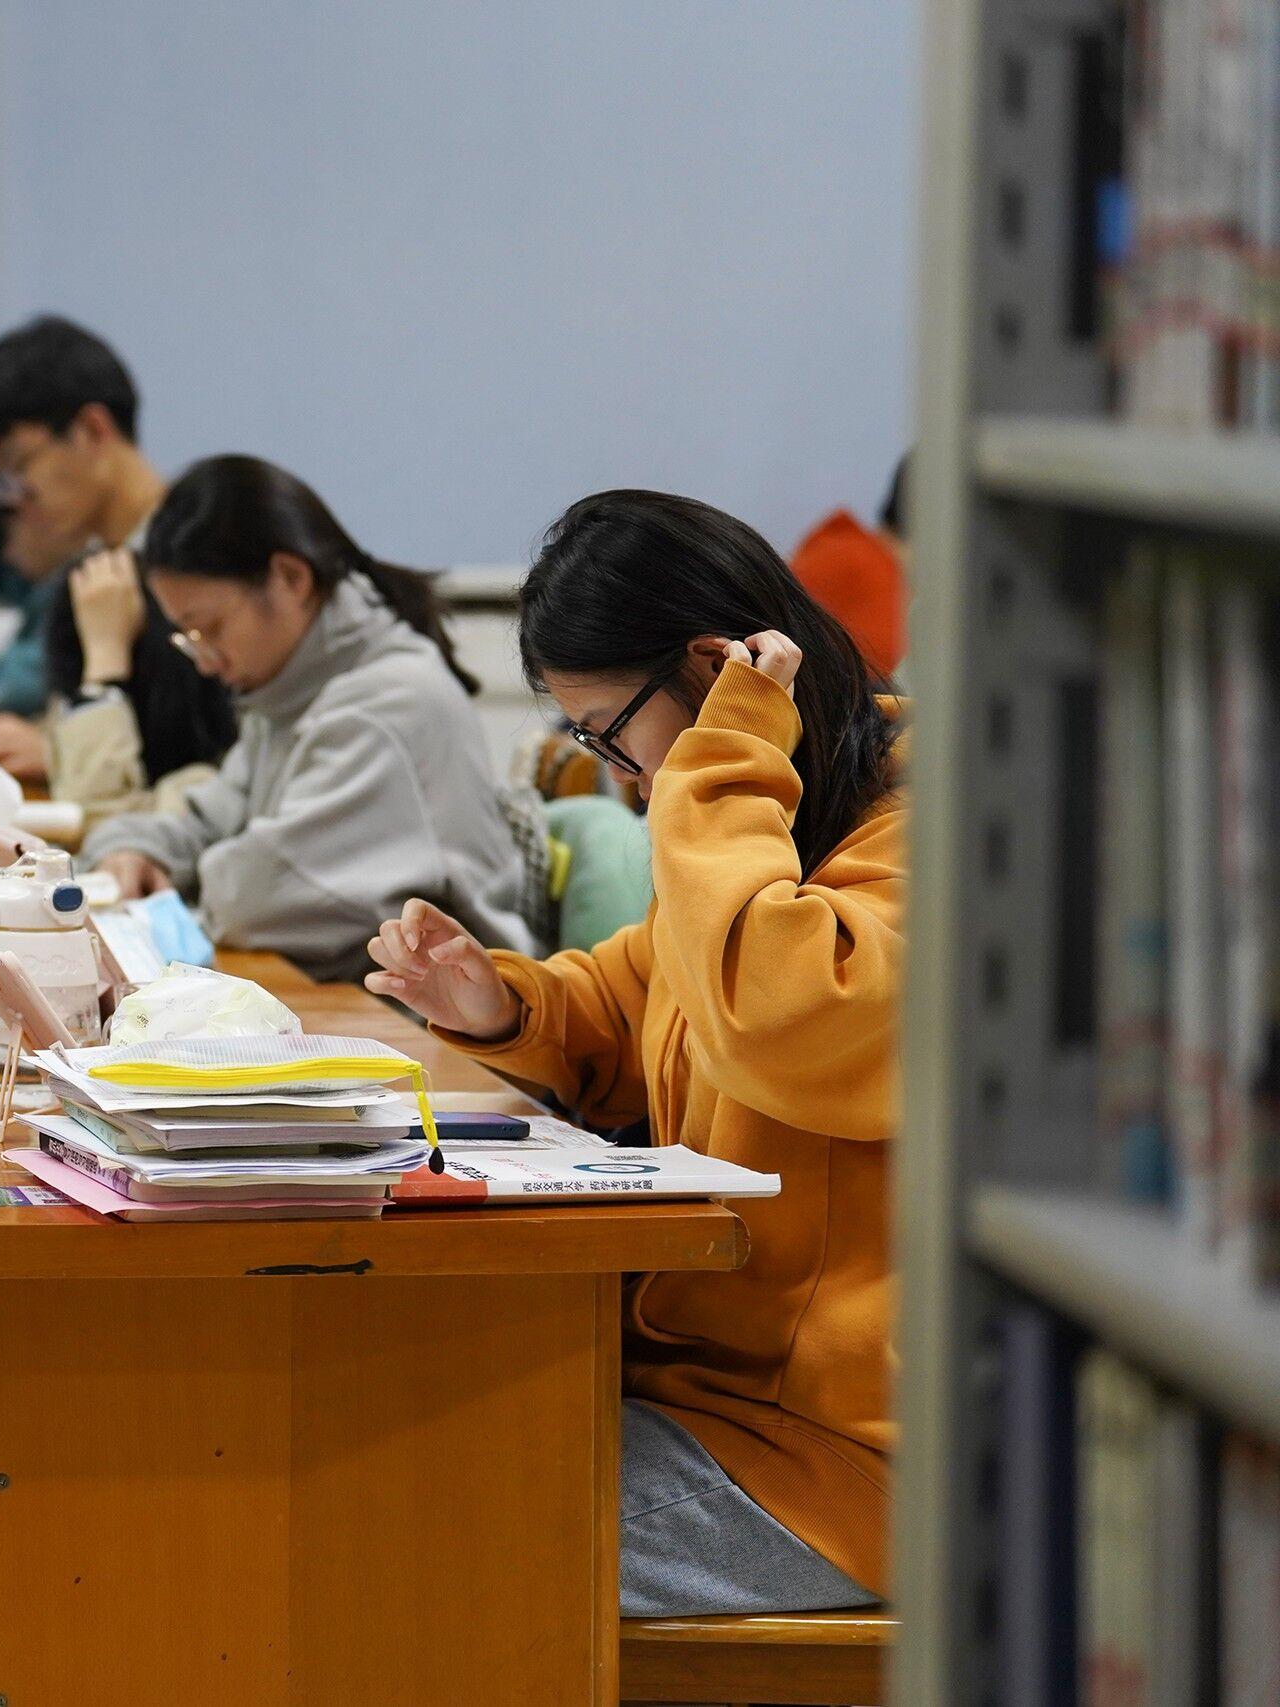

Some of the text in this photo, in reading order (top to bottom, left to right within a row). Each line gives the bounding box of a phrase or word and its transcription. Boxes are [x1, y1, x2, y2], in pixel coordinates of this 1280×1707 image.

[522, 1181, 585, 1193] 西安交通大学
